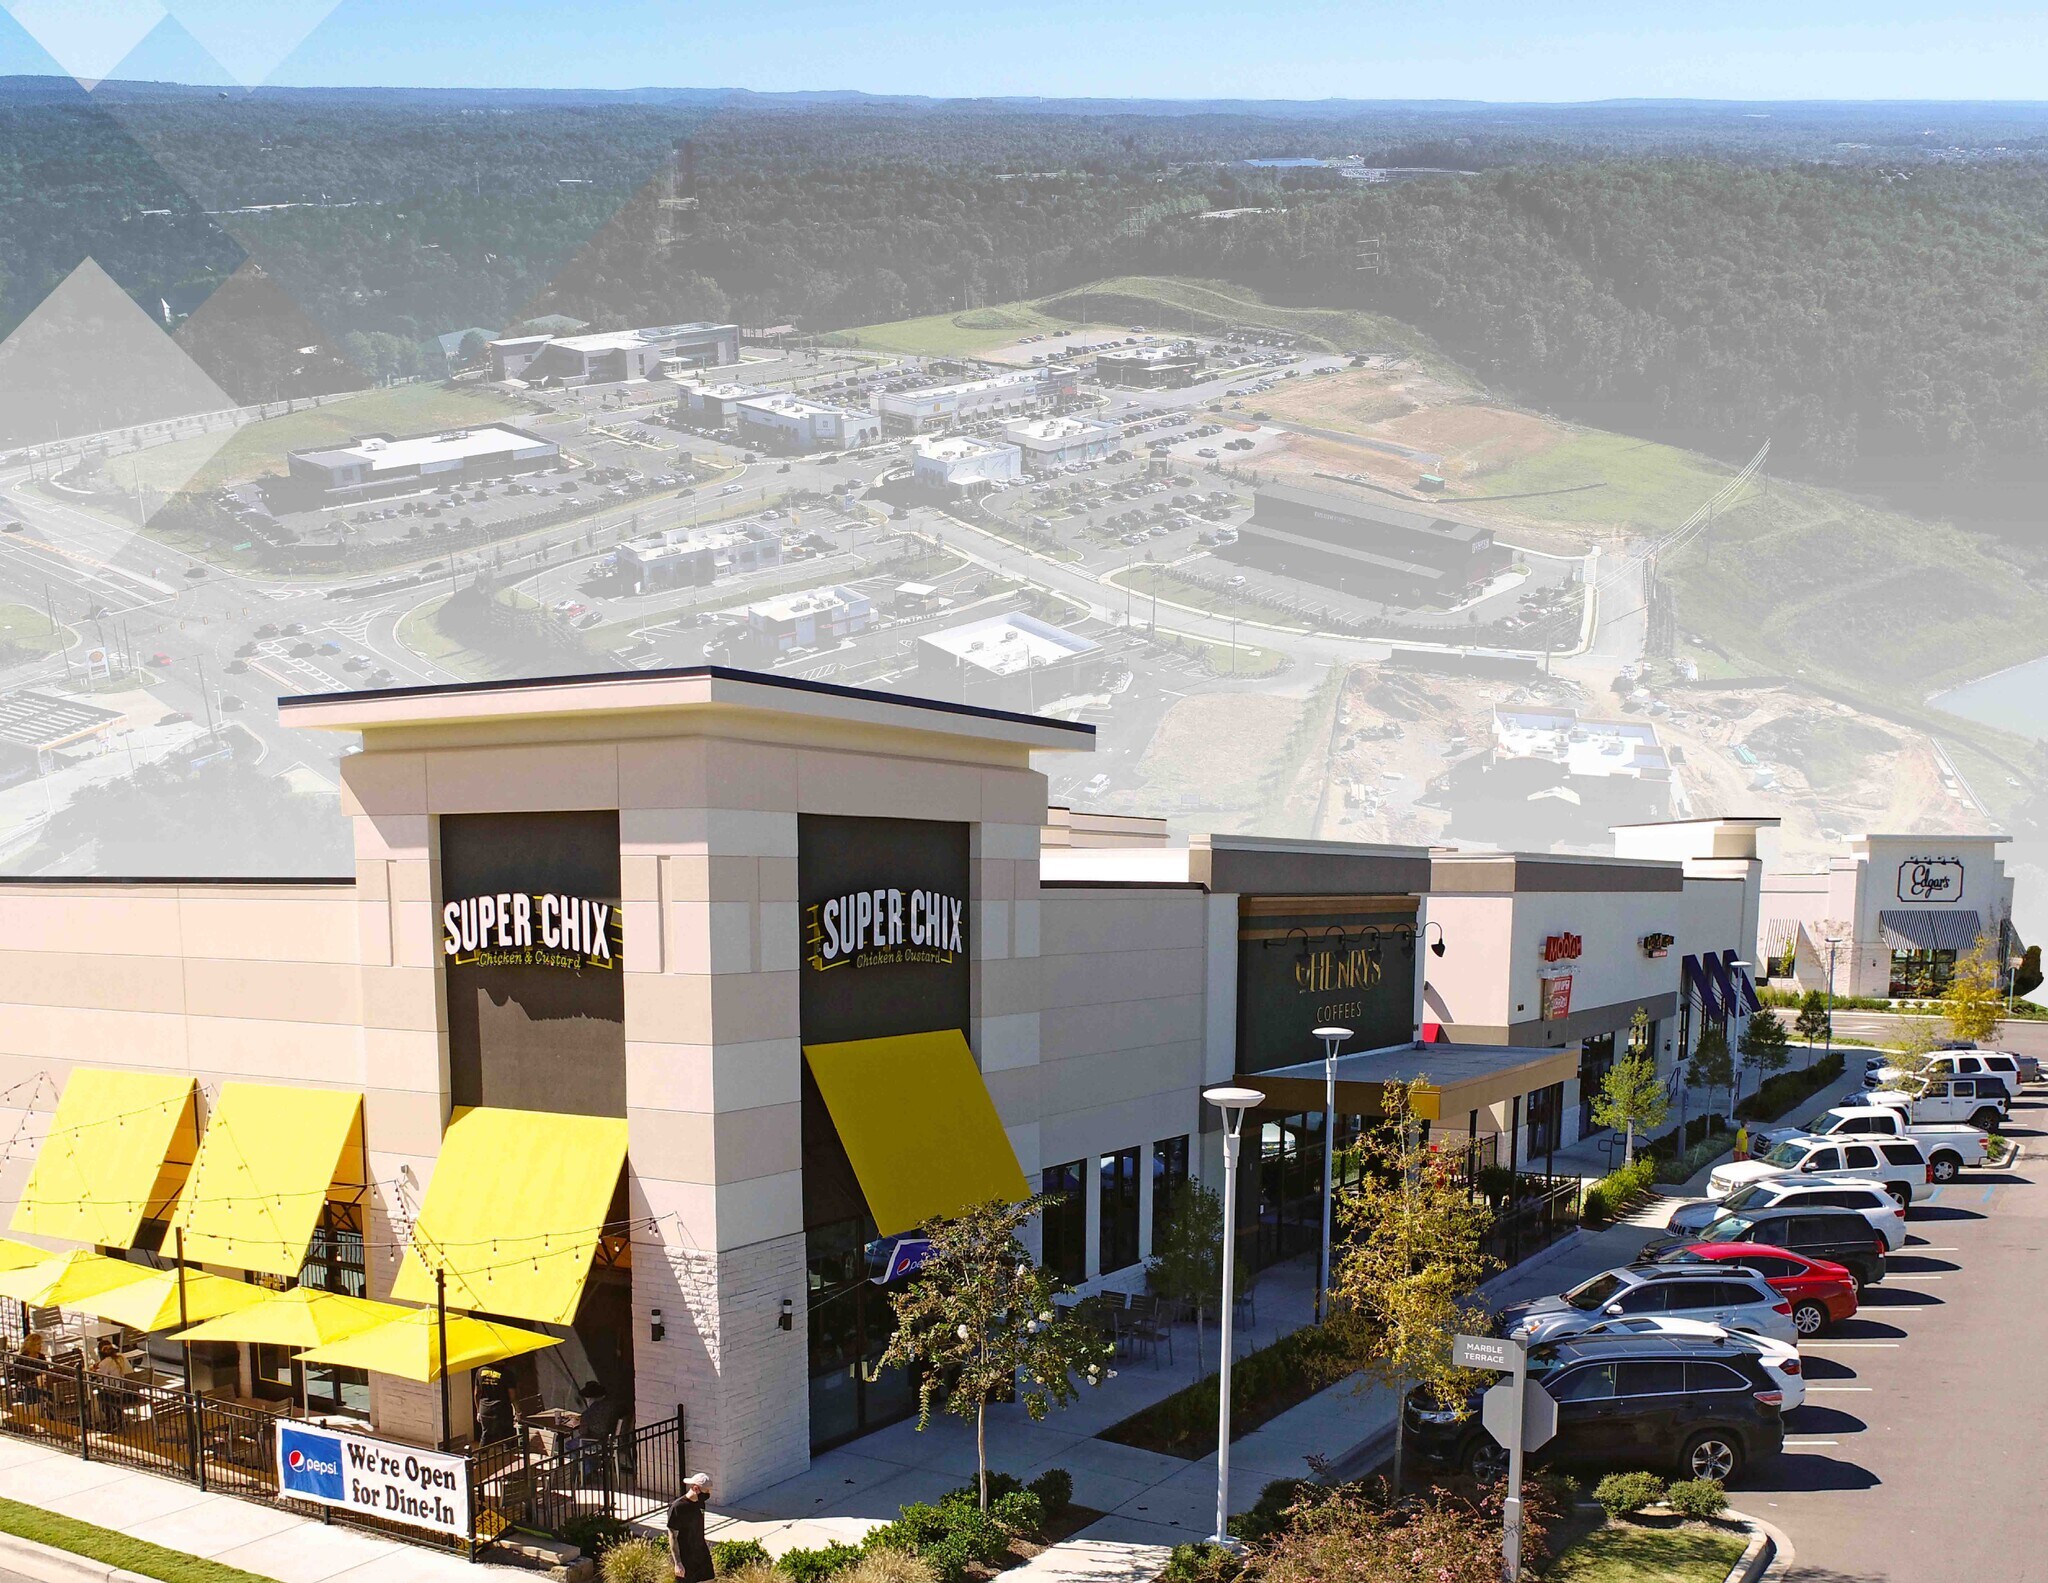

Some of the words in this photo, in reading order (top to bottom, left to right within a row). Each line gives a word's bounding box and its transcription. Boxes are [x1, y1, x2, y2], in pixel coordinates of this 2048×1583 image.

[1911, 865, 1950, 899] Edgar's
[443, 893, 532, 955] SUPER
[541, 893, 610, 960] CHIX
[823, 888, 903, 960] SUPER
[910, 889, 963, 954] CHIX
[478, 949, 523, 967] Chicken
[524, 952, 533, 962] &
[535, 950, 582, 970] Custard
[856, 950, 895, 969] Chicken
[896, 954, 903, 962] &
[904, 948, 941, 965] Custard
[1548, 934, 1582, 962] MOOYAH
[1316, 1001, 1361, 1023] COFFEES
[1464, 1352, 1504, 1364] TERRACE
[1466, 1343, 1503, 1354] MARBLE
[306, 1458, 337, 1475] pepsi
[347, 1443, 400, 1477] We're
[405, 1455, 457, 1491] Open
[352, 1478, 380, 1507] for
[385, 1485, 455, 1525] Dine-In
